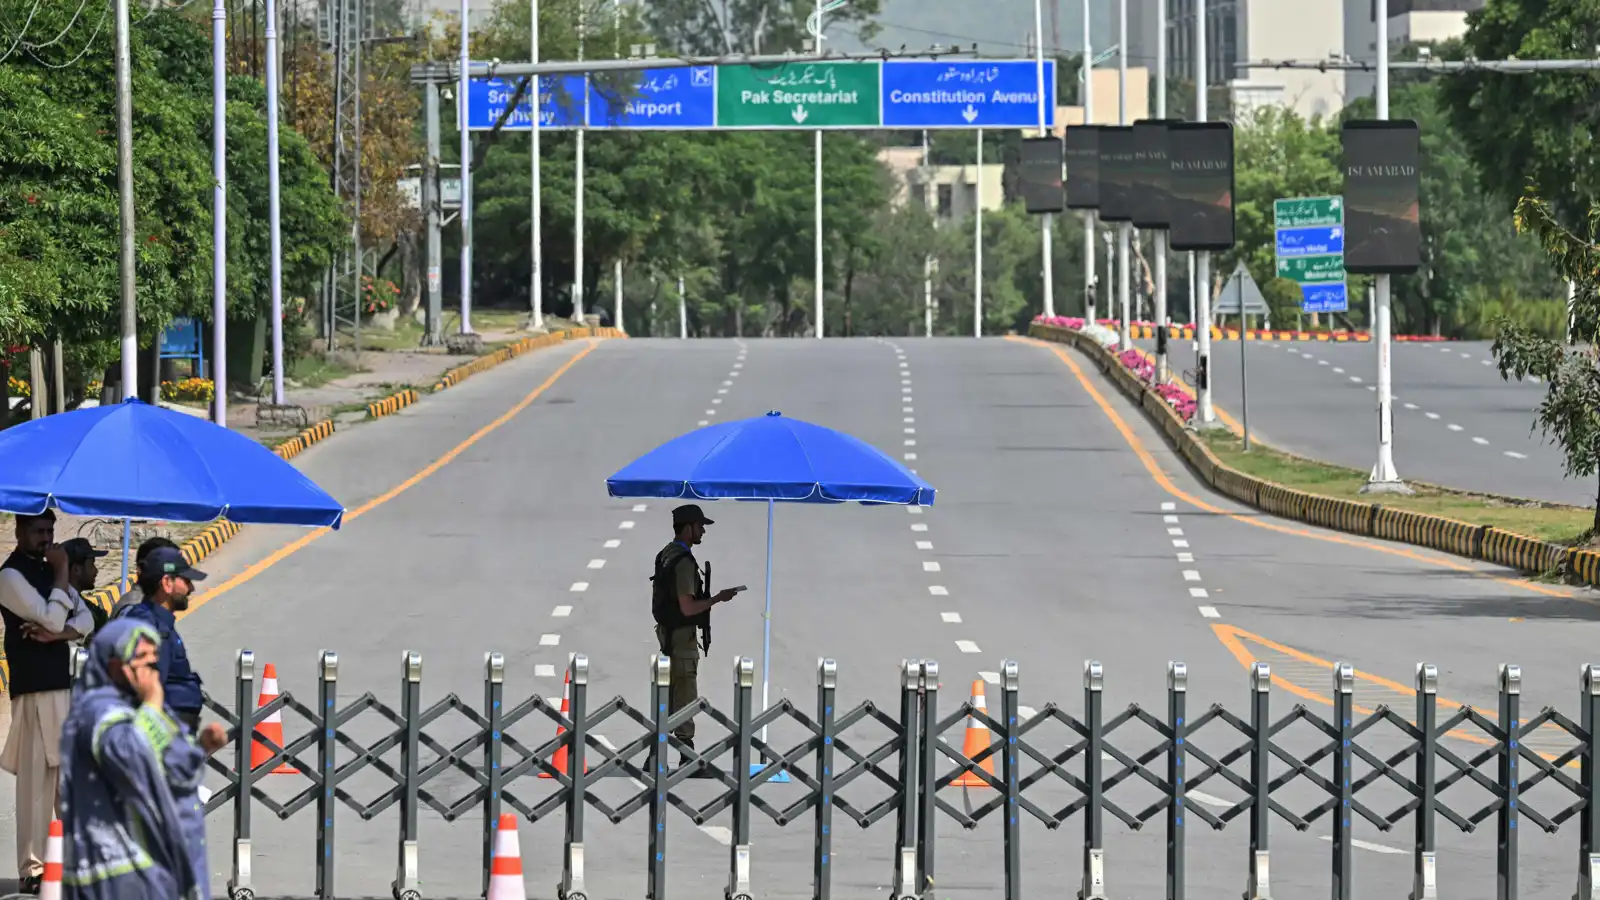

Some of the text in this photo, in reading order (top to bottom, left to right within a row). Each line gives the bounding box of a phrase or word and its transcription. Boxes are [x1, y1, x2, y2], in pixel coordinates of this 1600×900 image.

[741, 90, 858, 104] Pak Secretariat
[890, 89, 1038, 104] Constitution Avenu
[624, 100, 682, 118] Airport
[1170, 160, 1228, 171] ISLAMABAD
[1348, 165, 1415, 177] ISLAMABAD
[1510, 720, 1518, 829] POLICE
[821, 705, 833, 864] POLICE
